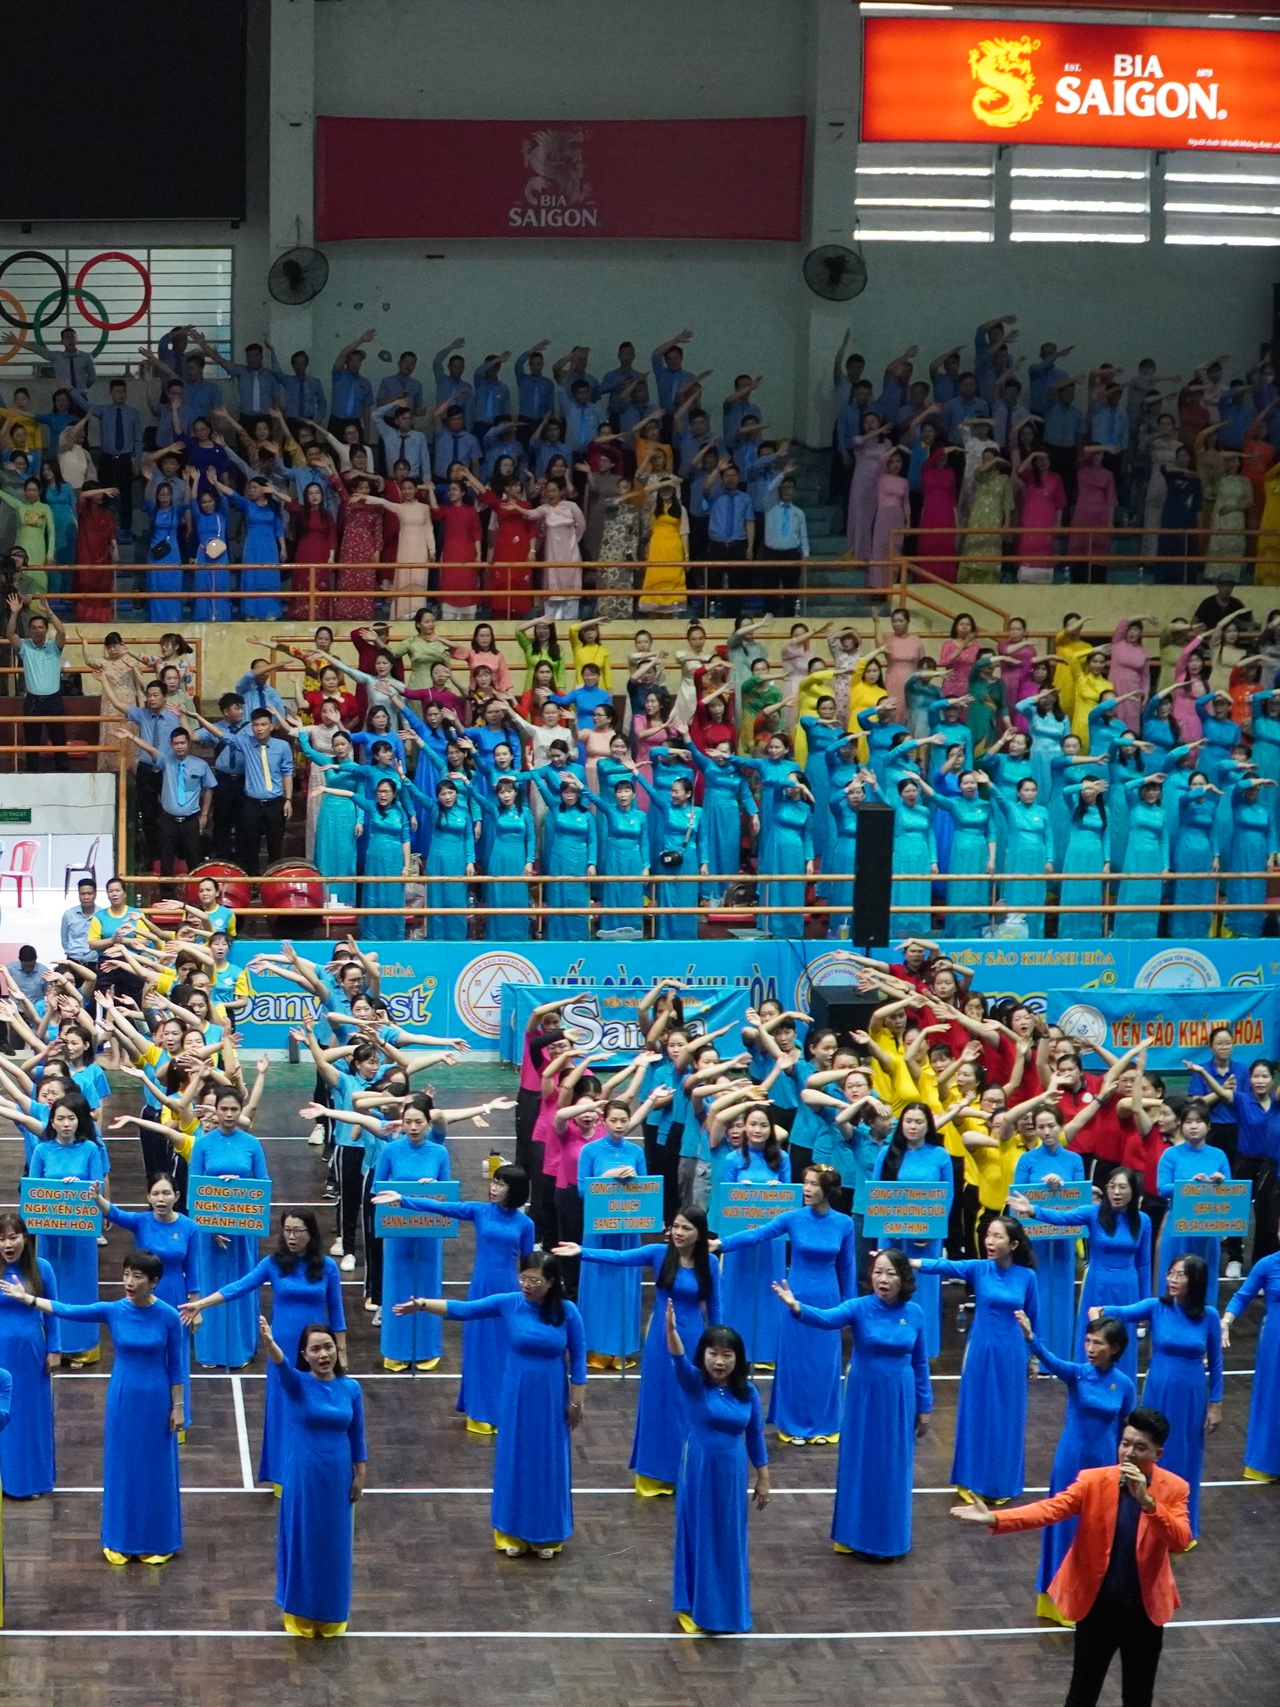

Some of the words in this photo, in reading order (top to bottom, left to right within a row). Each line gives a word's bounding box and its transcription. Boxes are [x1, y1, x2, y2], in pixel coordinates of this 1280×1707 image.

[1113, 53, 1164, 78] BIA
[540, 195, 567, 207] BIA
[509, 208, 598, 227] SAIGON
[950, 948, 982, 965] YẾN
[985, 949, 1017, 965] SÀO
[1022, 949, 1077, 965] KHÁNH
[1081, 949, 1115, 965] HÒA
[382, 964, 415, 978] HÒA
[1111, 1012, 1140, 1047] YẾN
[1146, 1013, 1175, 1047] SÀO
[1233, 1013, 1263, 1044] HÒA
[29, 1187, 60, 1199] CÔNG
[63, 1190, 78, 1200] TY
[197, 1185, 231, 1197] CÔNG
[232, 1188, 247, 1198] TY
[248, 1189, 264, 1200] CP
[25, 1203, 49, 1214] NGK
[51, 1202, 72, 1214] YẾN
[75, 1204, 98, 1216] SÀO
[195, 1200, 219, 1211] NGK
[222, 1202, 265, 1215] SANEST
[609, 1200, 620, 1212] DU
[27, 1217, 68, 1229] KHÁNH
[70, 1219, 95, 1230] HÒA
[195, 1214, 236, 1227] KHÁNH
[238, 1217, 264, 1230] HÒA
[594, 1218, 622, 1230] SANEST
[624, 1217, 655, 1229] TOURIST
[884, 1222, 902, 1234] CAM
